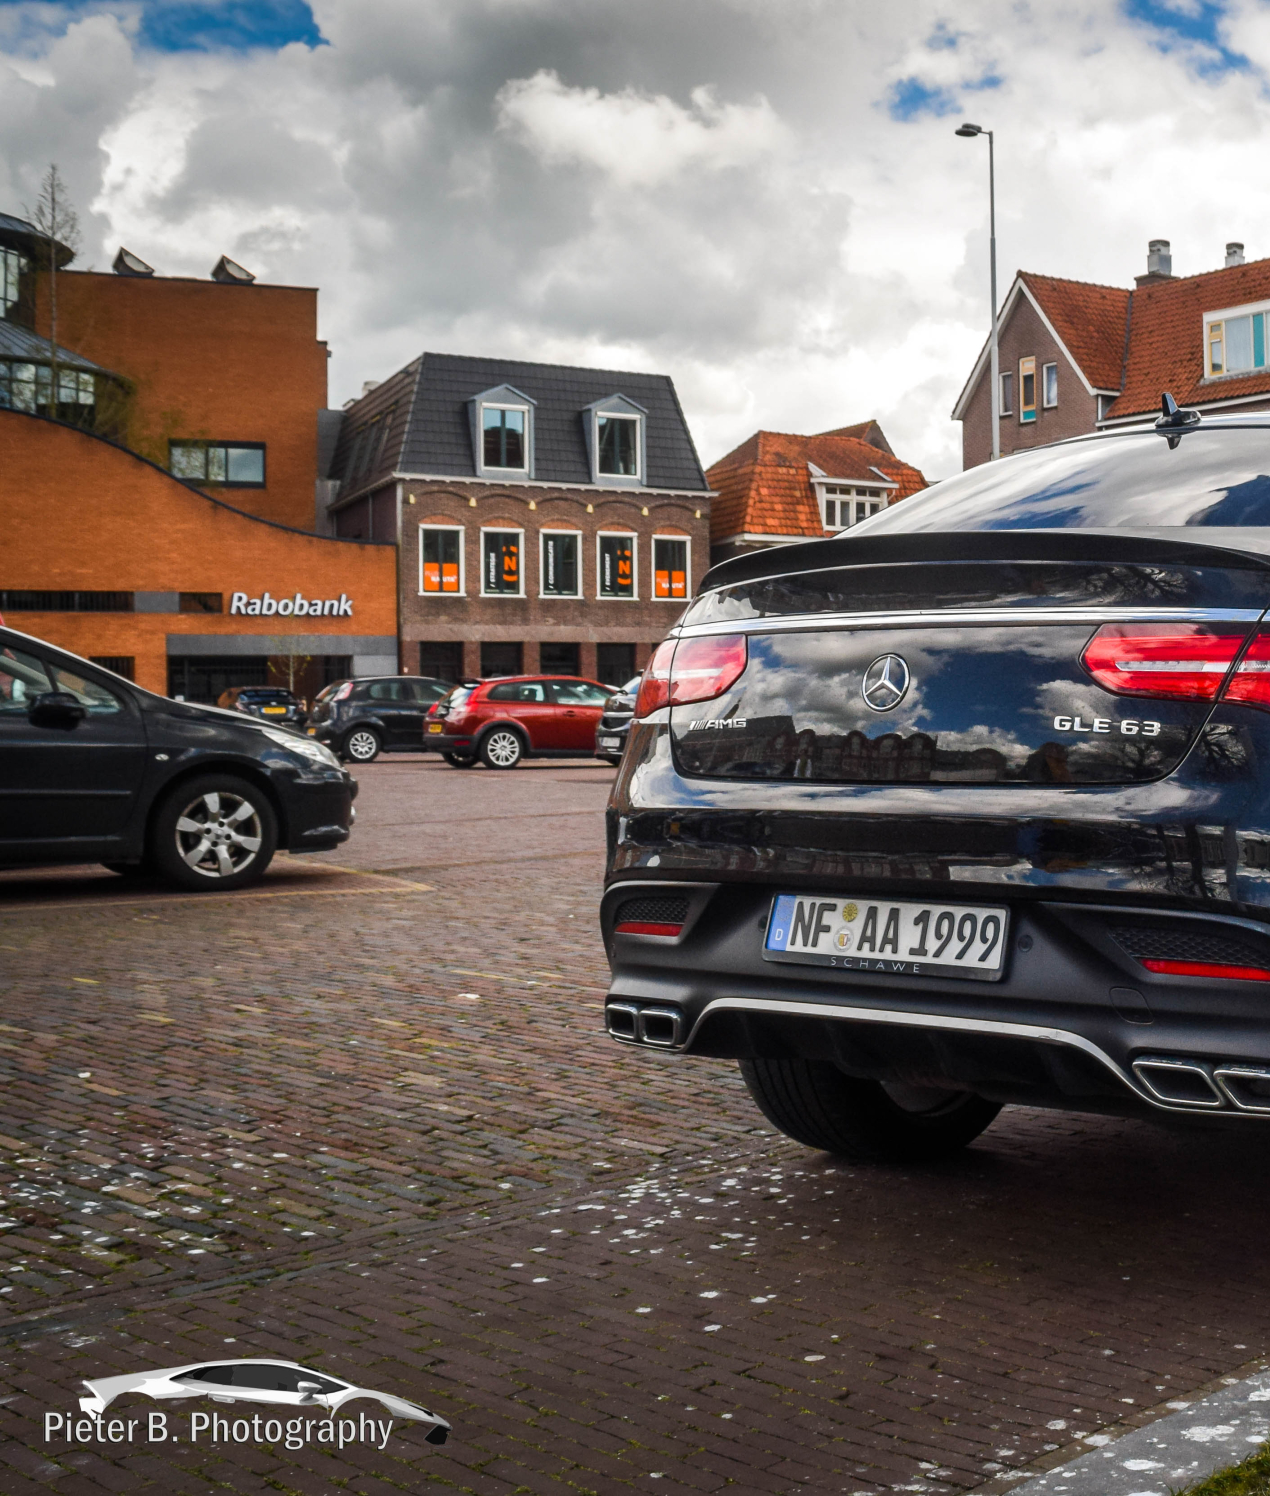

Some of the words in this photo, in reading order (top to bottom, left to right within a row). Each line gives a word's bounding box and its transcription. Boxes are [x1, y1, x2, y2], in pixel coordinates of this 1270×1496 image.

[230, 592, 353, 616] Rabobank
[704, 718, 747, 730] AMG
[1053, 715, 1112, 733] GLE
[1120, 720, 1161, 736] 63
[774, 928, 783, 941] D
[790, 901, 837, 948] NF
[856, 906, 900, 954] AA
[908, 910, 1000, 962] 1999
[830, 956, 920, 974] SCHAWE
